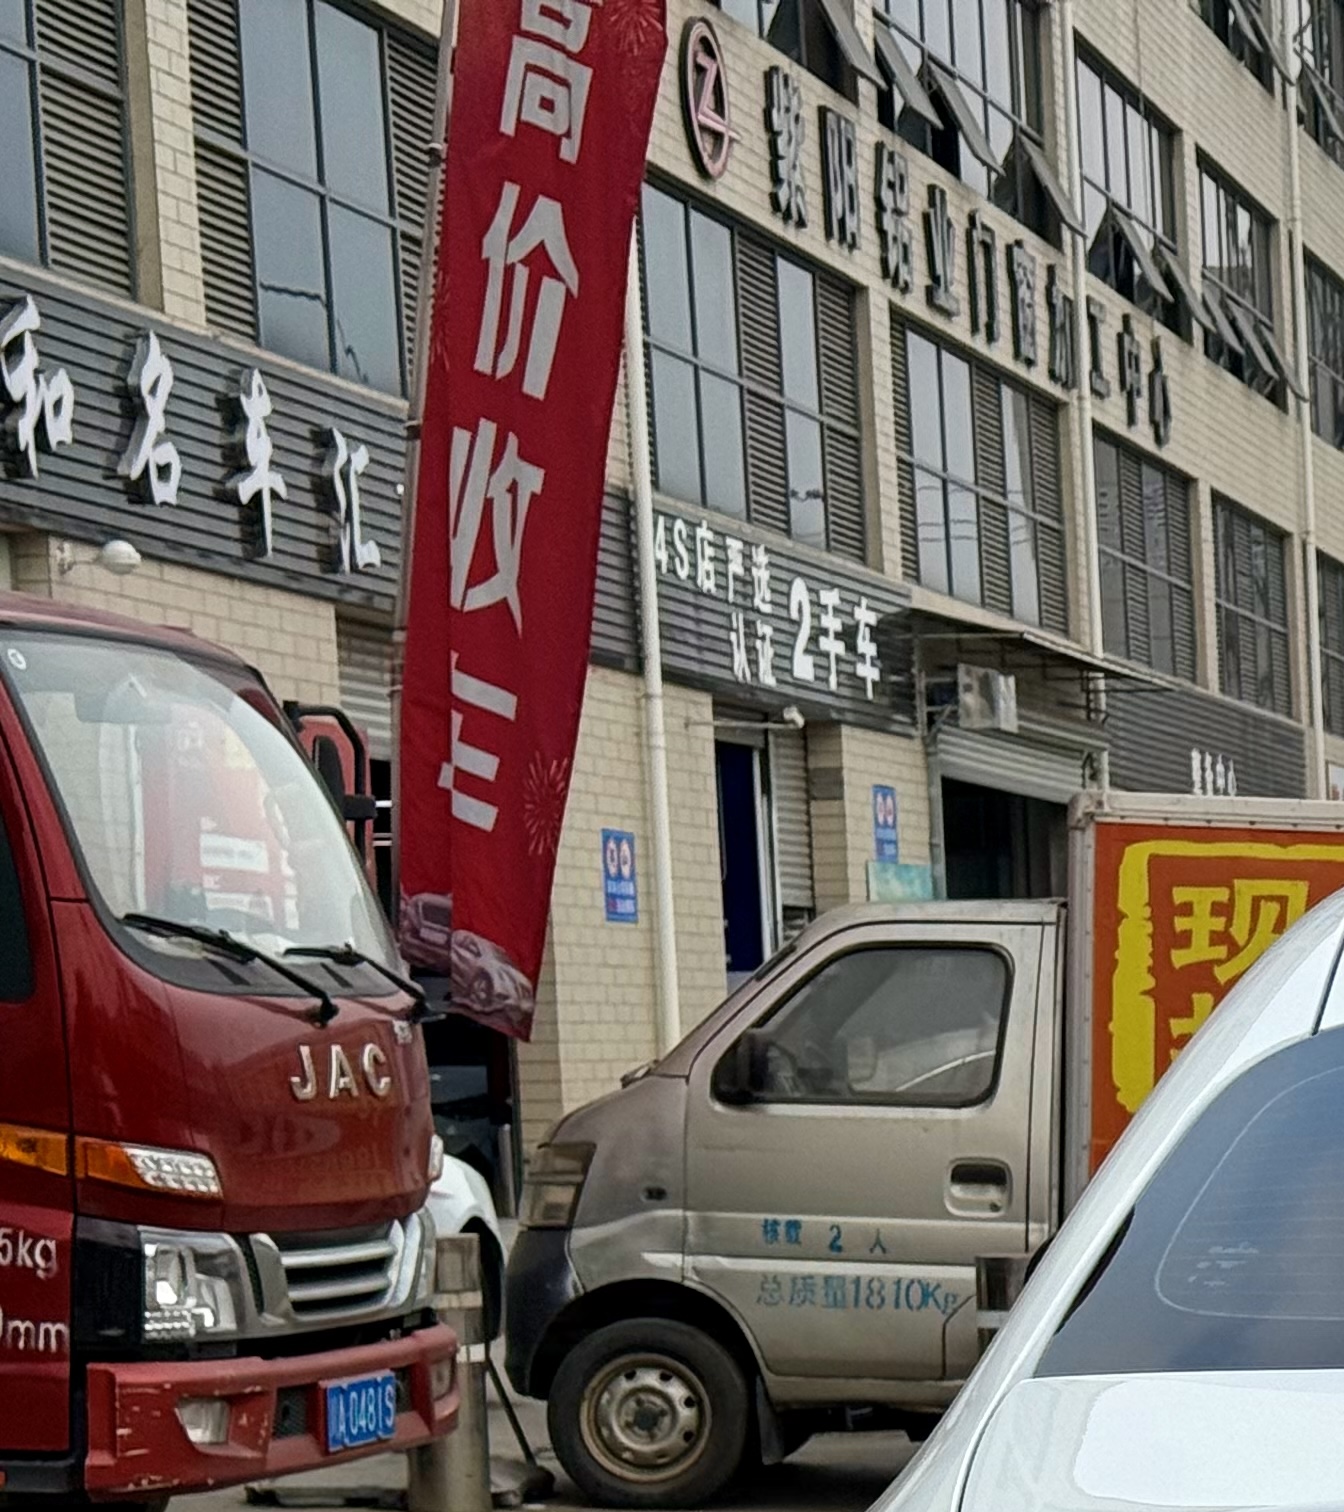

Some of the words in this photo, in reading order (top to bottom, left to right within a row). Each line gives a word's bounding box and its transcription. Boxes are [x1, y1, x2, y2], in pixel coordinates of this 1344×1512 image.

[655, 515, 773, 614] 4S店严选
[729, 611, 777, 688] 认证
[789, 576, 881, 700] 2手车
[289, 1043, 392, 1100] JAC
[828, 1223, 843, 1254] 2
[868, 1227, 888, 1254] 人
